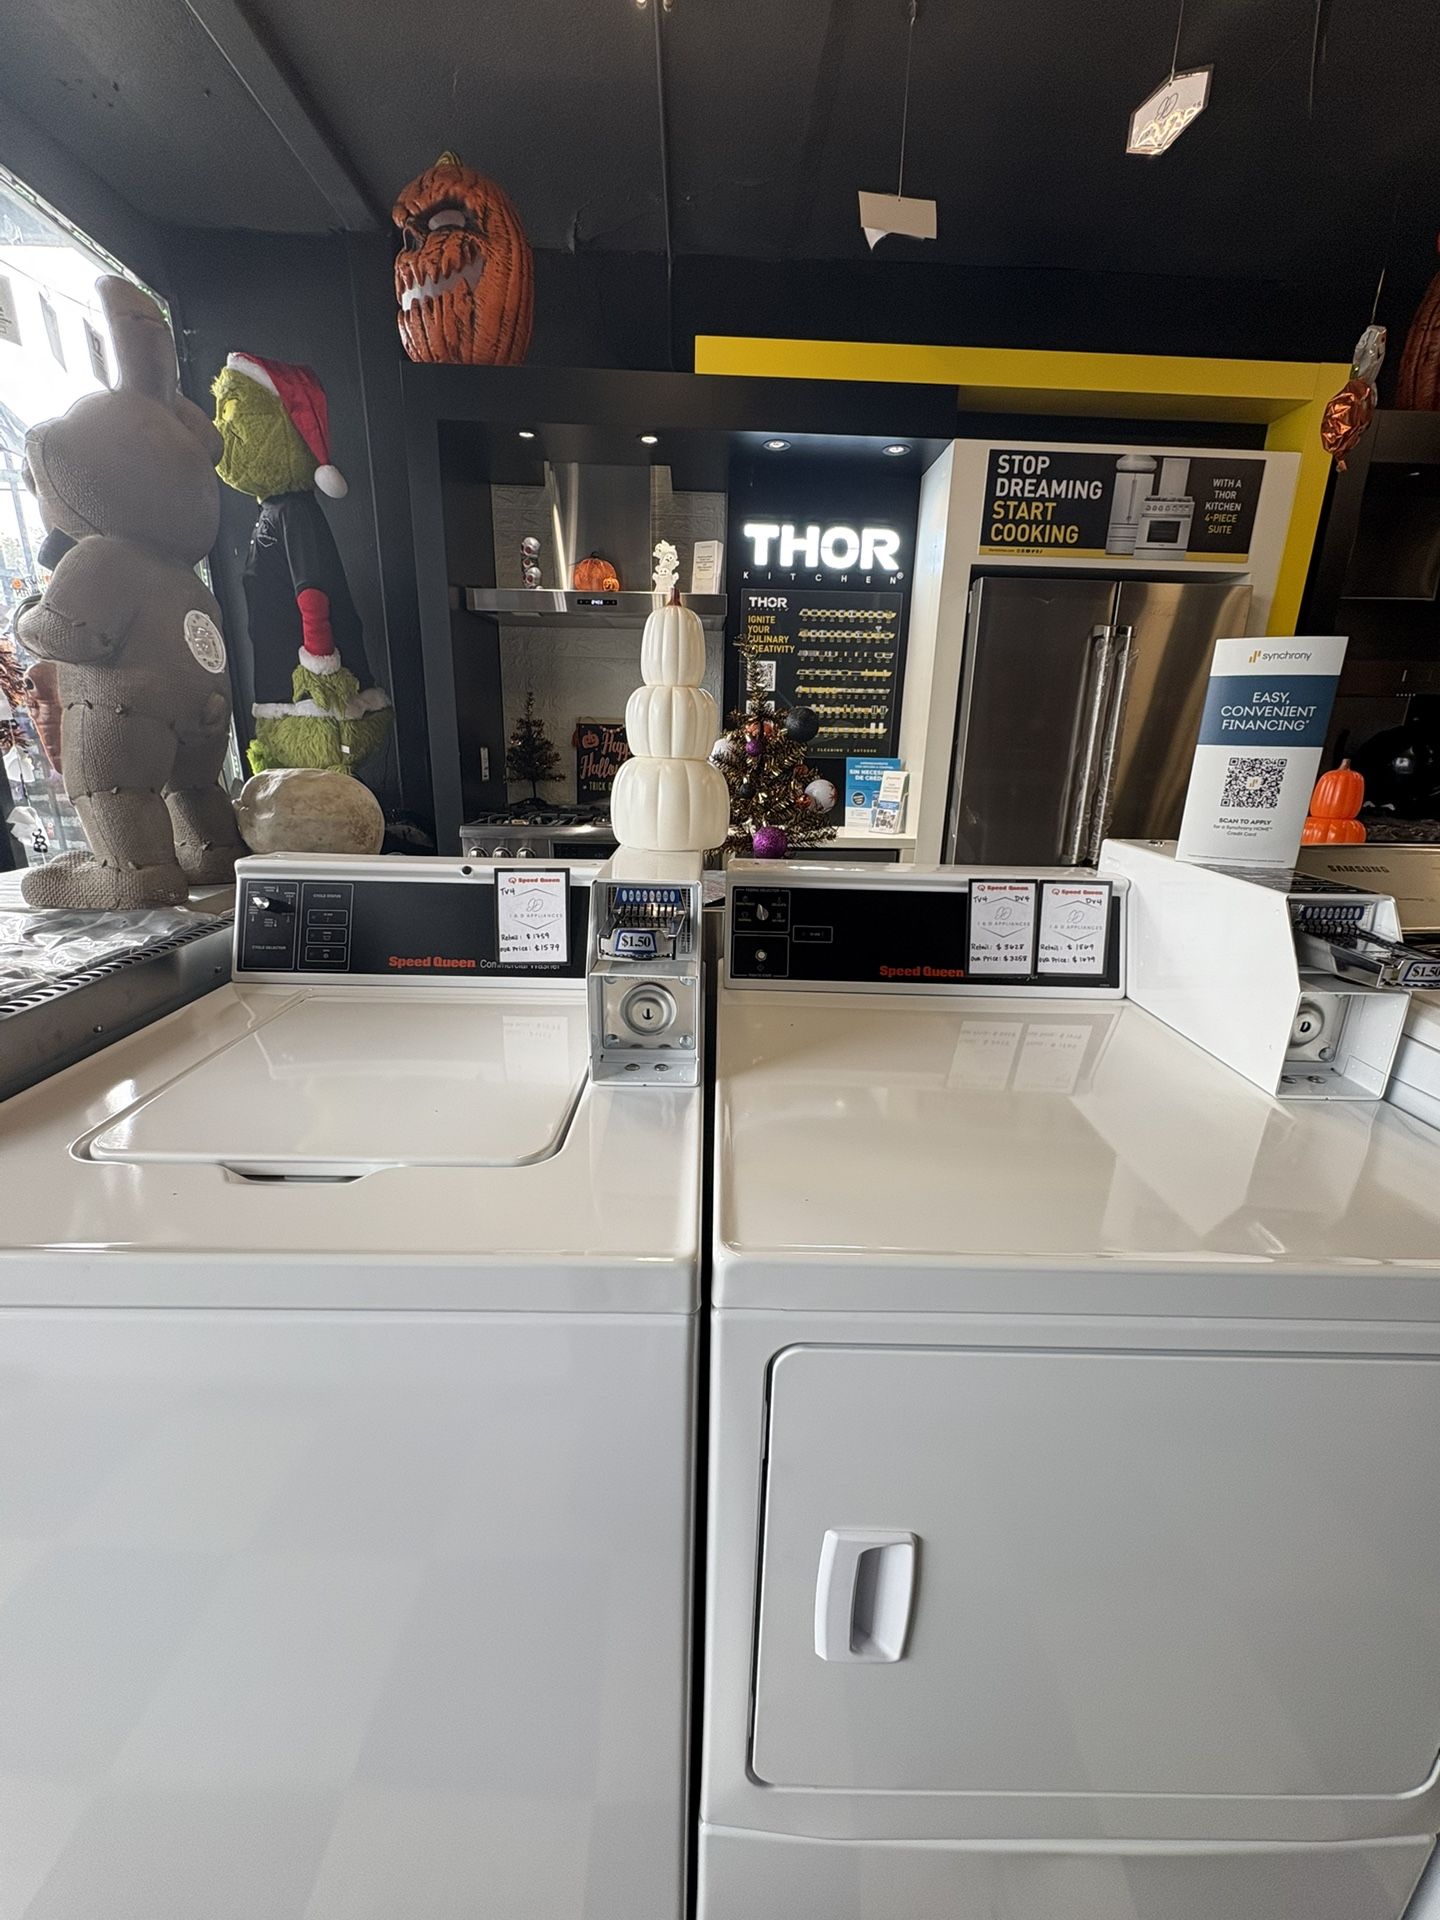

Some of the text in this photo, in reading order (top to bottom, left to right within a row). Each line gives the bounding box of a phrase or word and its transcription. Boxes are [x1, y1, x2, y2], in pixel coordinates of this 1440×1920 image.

[997, 454, 1050, 475] STOP
[995, 477, 1103, 499] DREAMING
[1213, 478, 1242, 488] WITH A
[1214, 490, 1237, 500] THOR
[992, 501, 1057, 520] START
[1205, 502, 1242, 511] KITCHEN
[1205, 513, 1238, 523] 4-PIECE
[991, 523, 1079, 544] COOKING
[1208, 524, 1232, 534] SUITE
[743, 523, 901, 571] THOR
[748, 596, 788, 608] THOR
[748, 615, 776, 624] IGNITE
[748, 624, 770, 634] YOUR
[1262, 651, 1312, 661] synchrony
[1252, 692, 1290, 704] EASY,
[1220, 705, 1317, 717] CONVENIENT
[601, 731, 630, 762] Happ
[589, 782, 606, 791] TRICK
[1327, 865, 1390, 873] SAMSUNG
[622, 934, 651, 948] $1.50
[388, 956, 432, 969] Speed
[433, 956, 476, 968] Queen
[880, 965, 965, 978] Speed Queen
